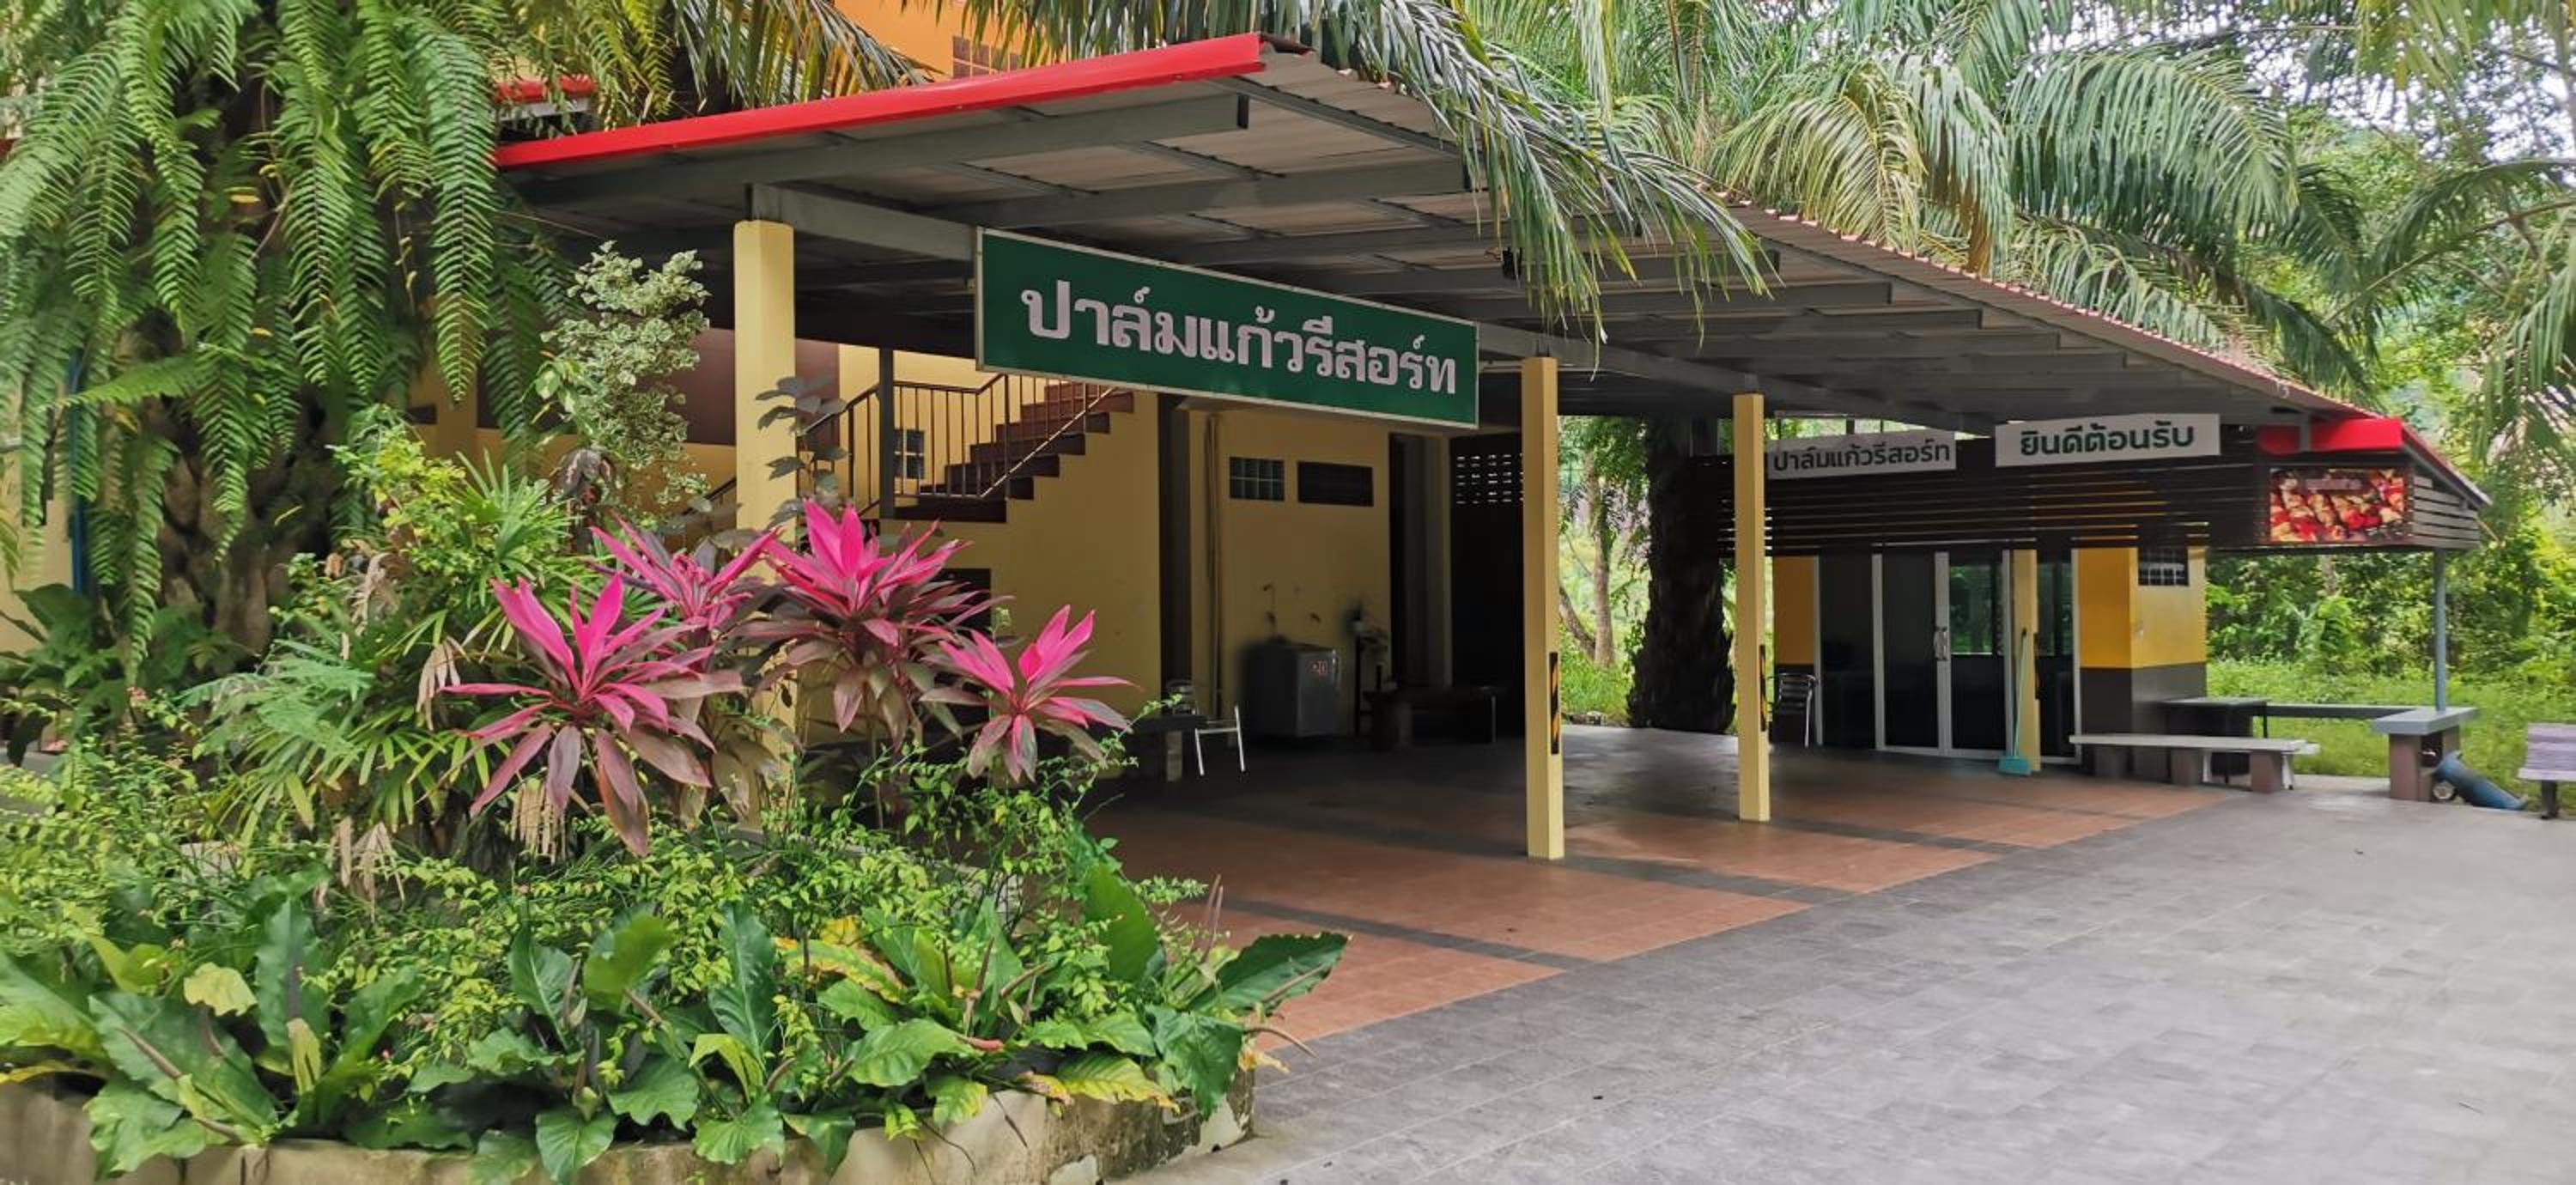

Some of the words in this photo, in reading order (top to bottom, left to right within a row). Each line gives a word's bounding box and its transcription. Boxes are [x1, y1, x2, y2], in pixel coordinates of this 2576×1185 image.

[1021, 280, 1455, 393] ปาล์มแก้วรีสอร์ท
[1773, 438, 1950, 471] ปาล์มแก้วรีสอร์ท
[2020, 420, 2194, 456] ยินดีต้อนรับ
